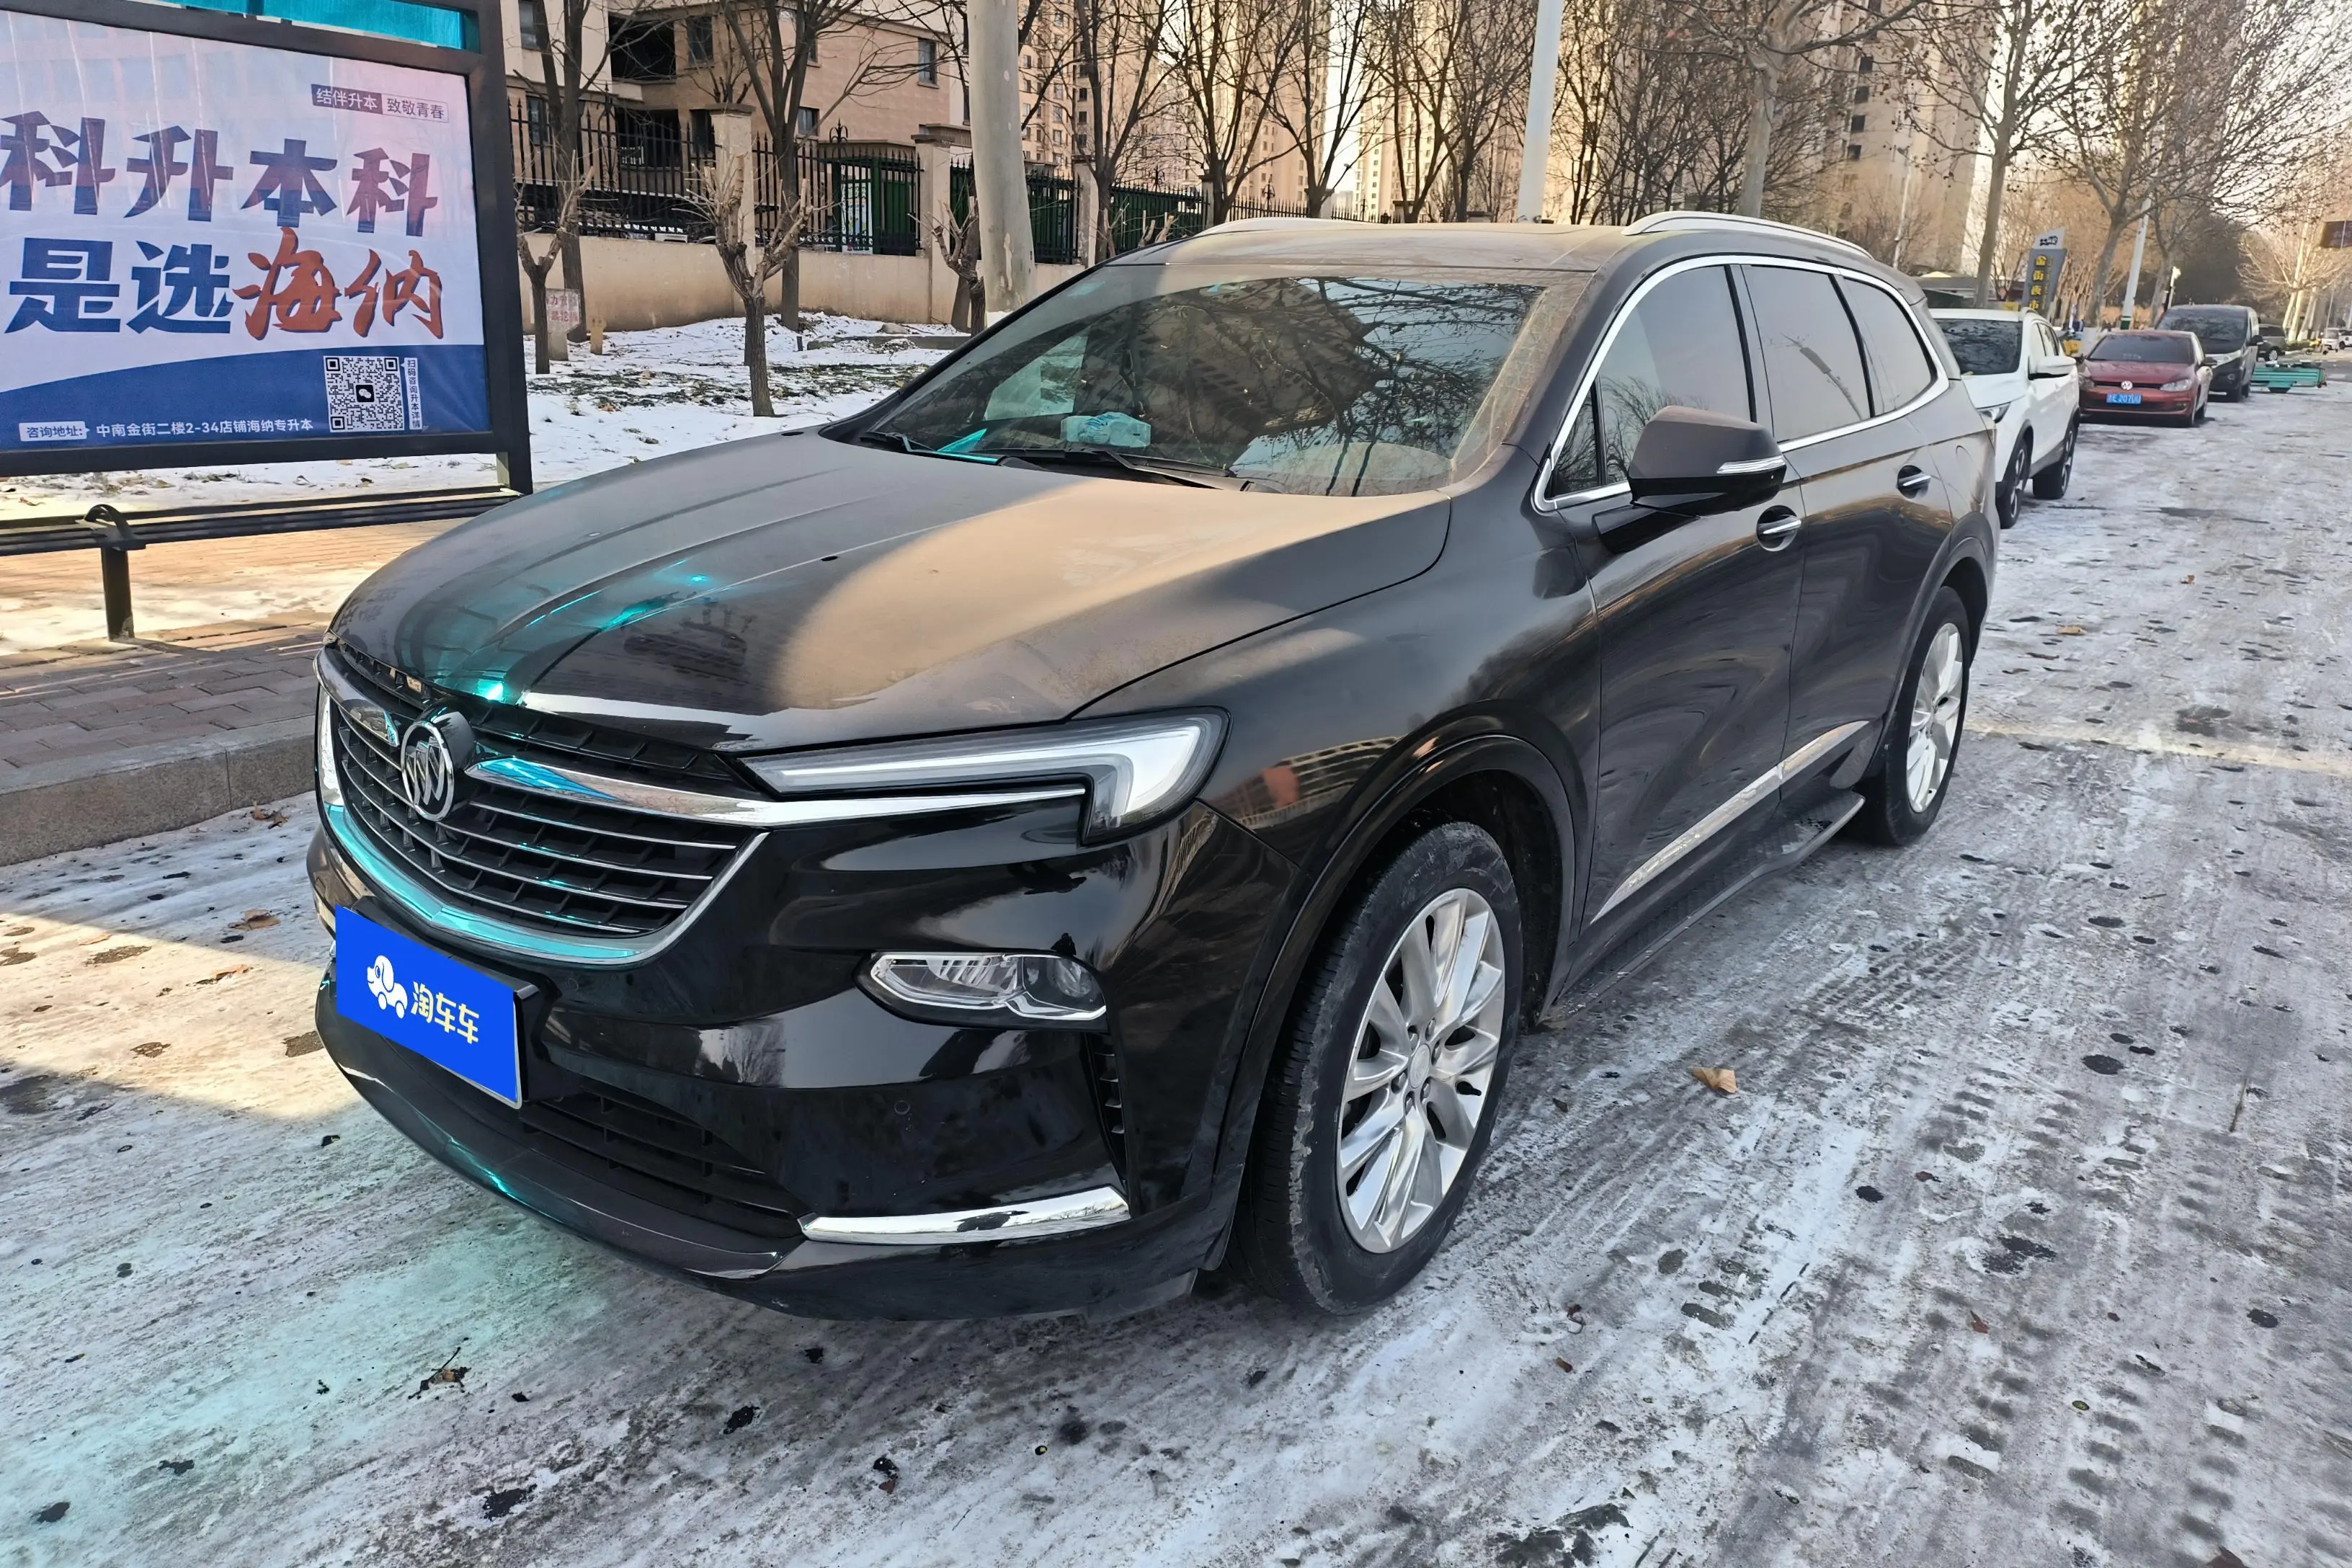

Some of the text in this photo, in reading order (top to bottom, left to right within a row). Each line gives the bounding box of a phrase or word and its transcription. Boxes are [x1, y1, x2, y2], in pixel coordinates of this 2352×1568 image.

[316, 88, 444, 119] 结伴升本 致敬青春
[0, 111, 438, 237] 科升本科
[407, 360, 420, 428] 扫码咨询升本详情
[97, 419, 313, 437] 中南金街二楼2-34店铺海纳专升本
